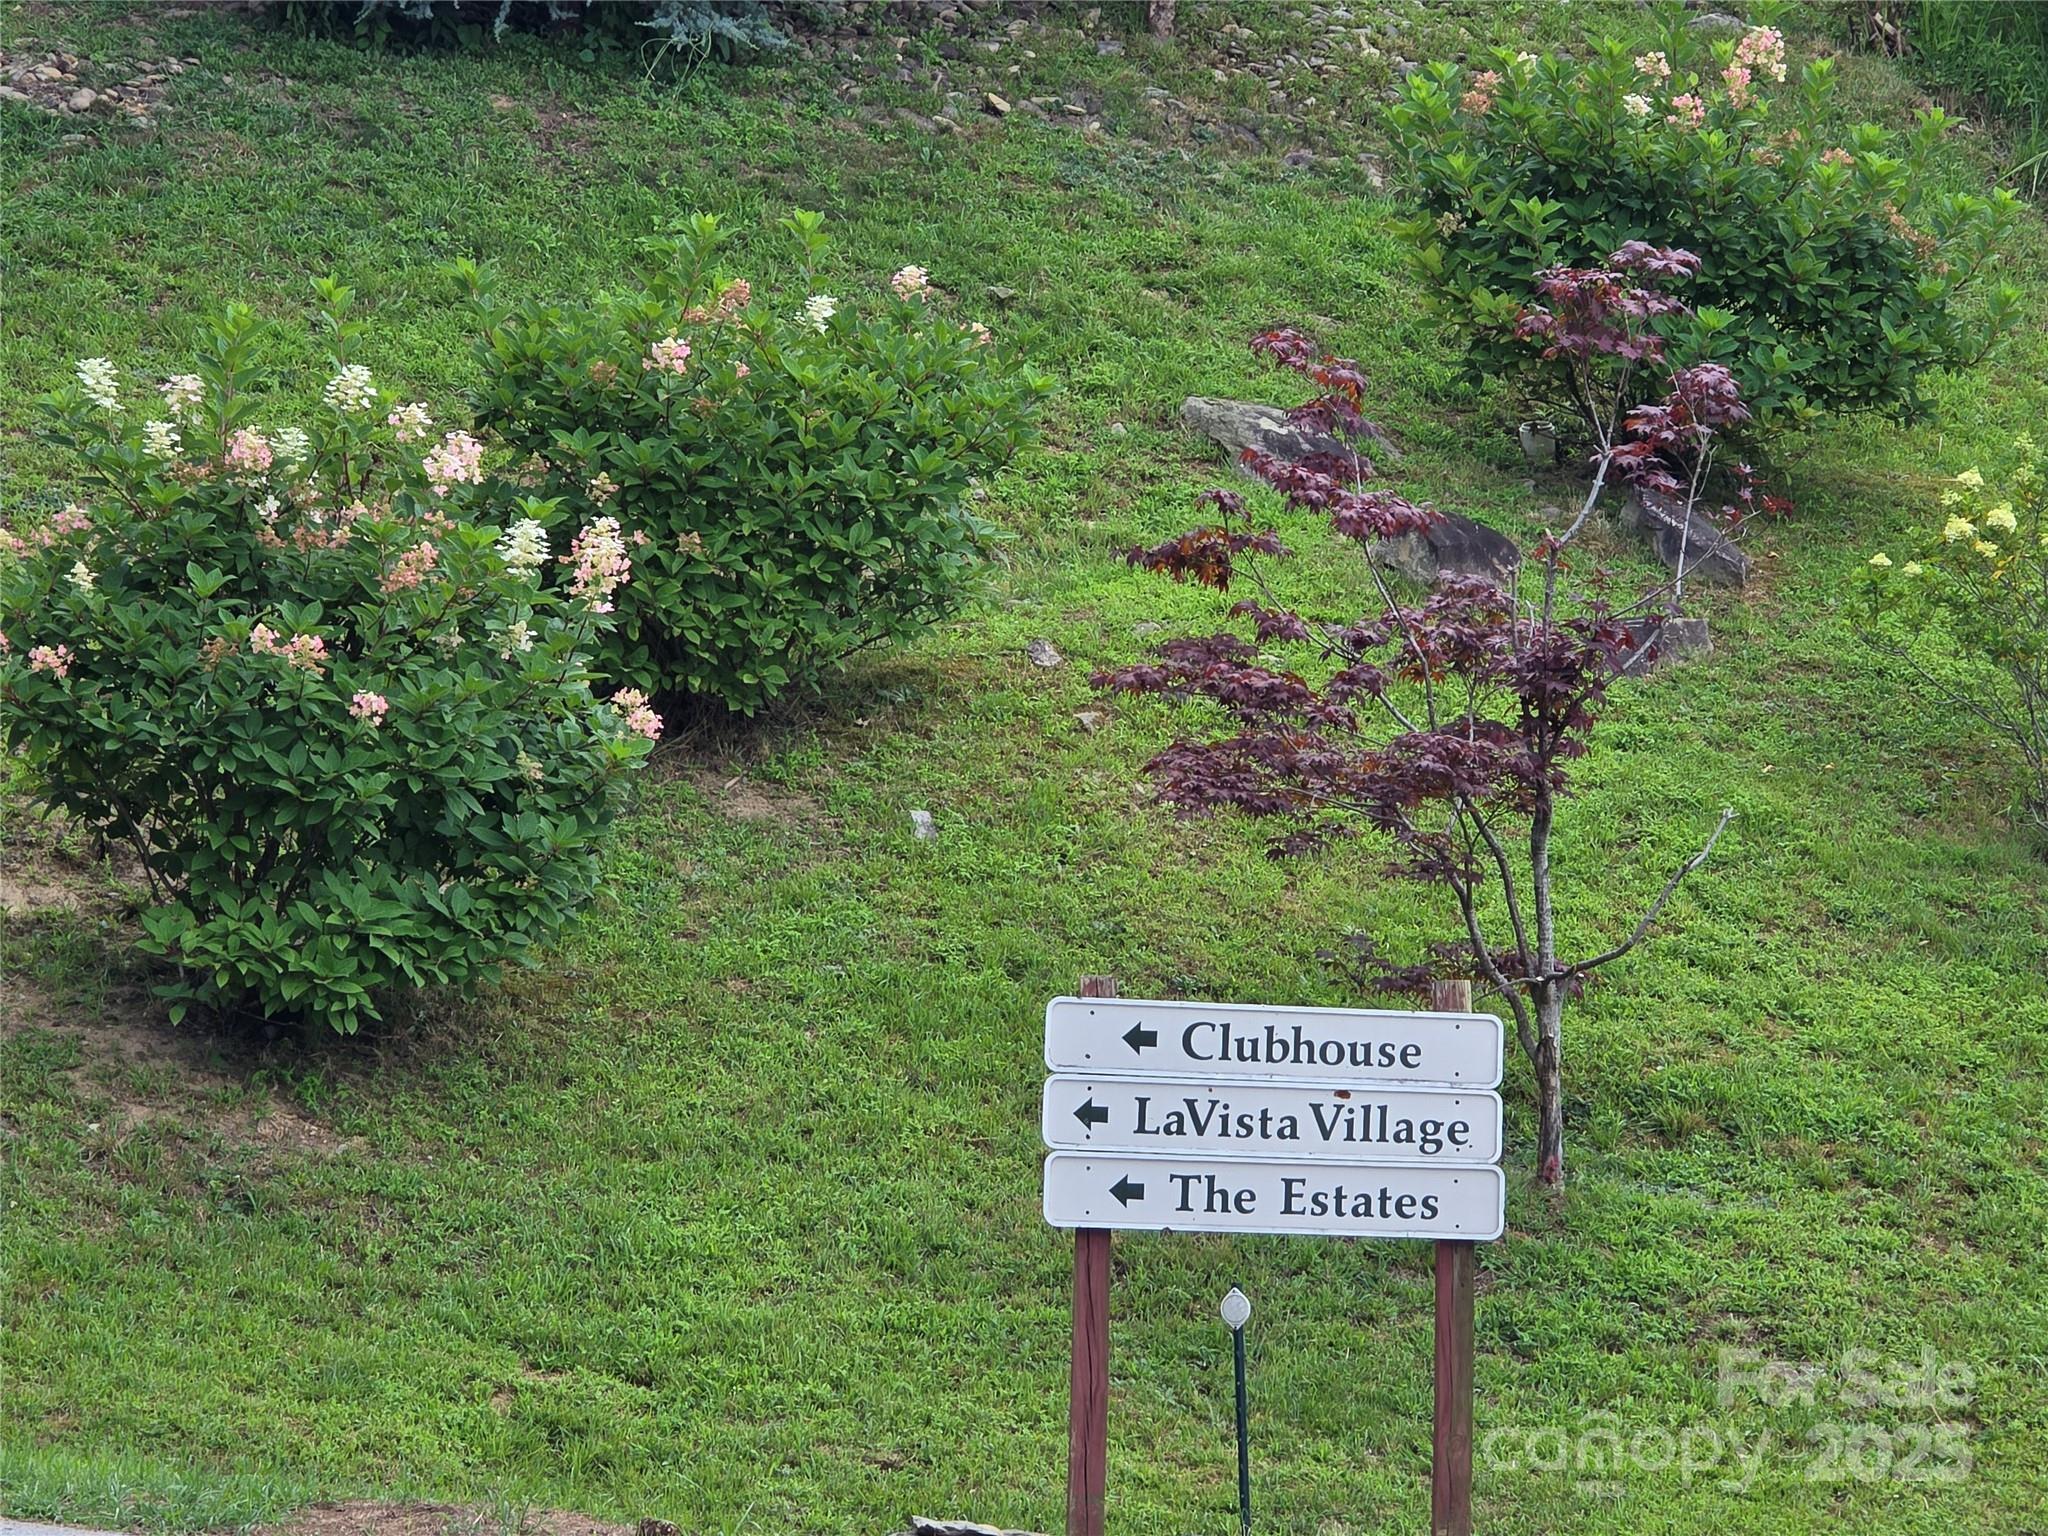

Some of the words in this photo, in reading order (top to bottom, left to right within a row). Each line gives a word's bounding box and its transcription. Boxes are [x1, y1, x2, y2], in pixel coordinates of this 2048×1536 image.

[1181, 1021, 1423, 1069] Clubhouse
[1132, 1096, 1300, 1140] LaVista
[1308, 1102, 1471, 1155] Village
[1168, 1173, 1257, 1216] The
[1279, 1177, 1440, 1221] Estates
